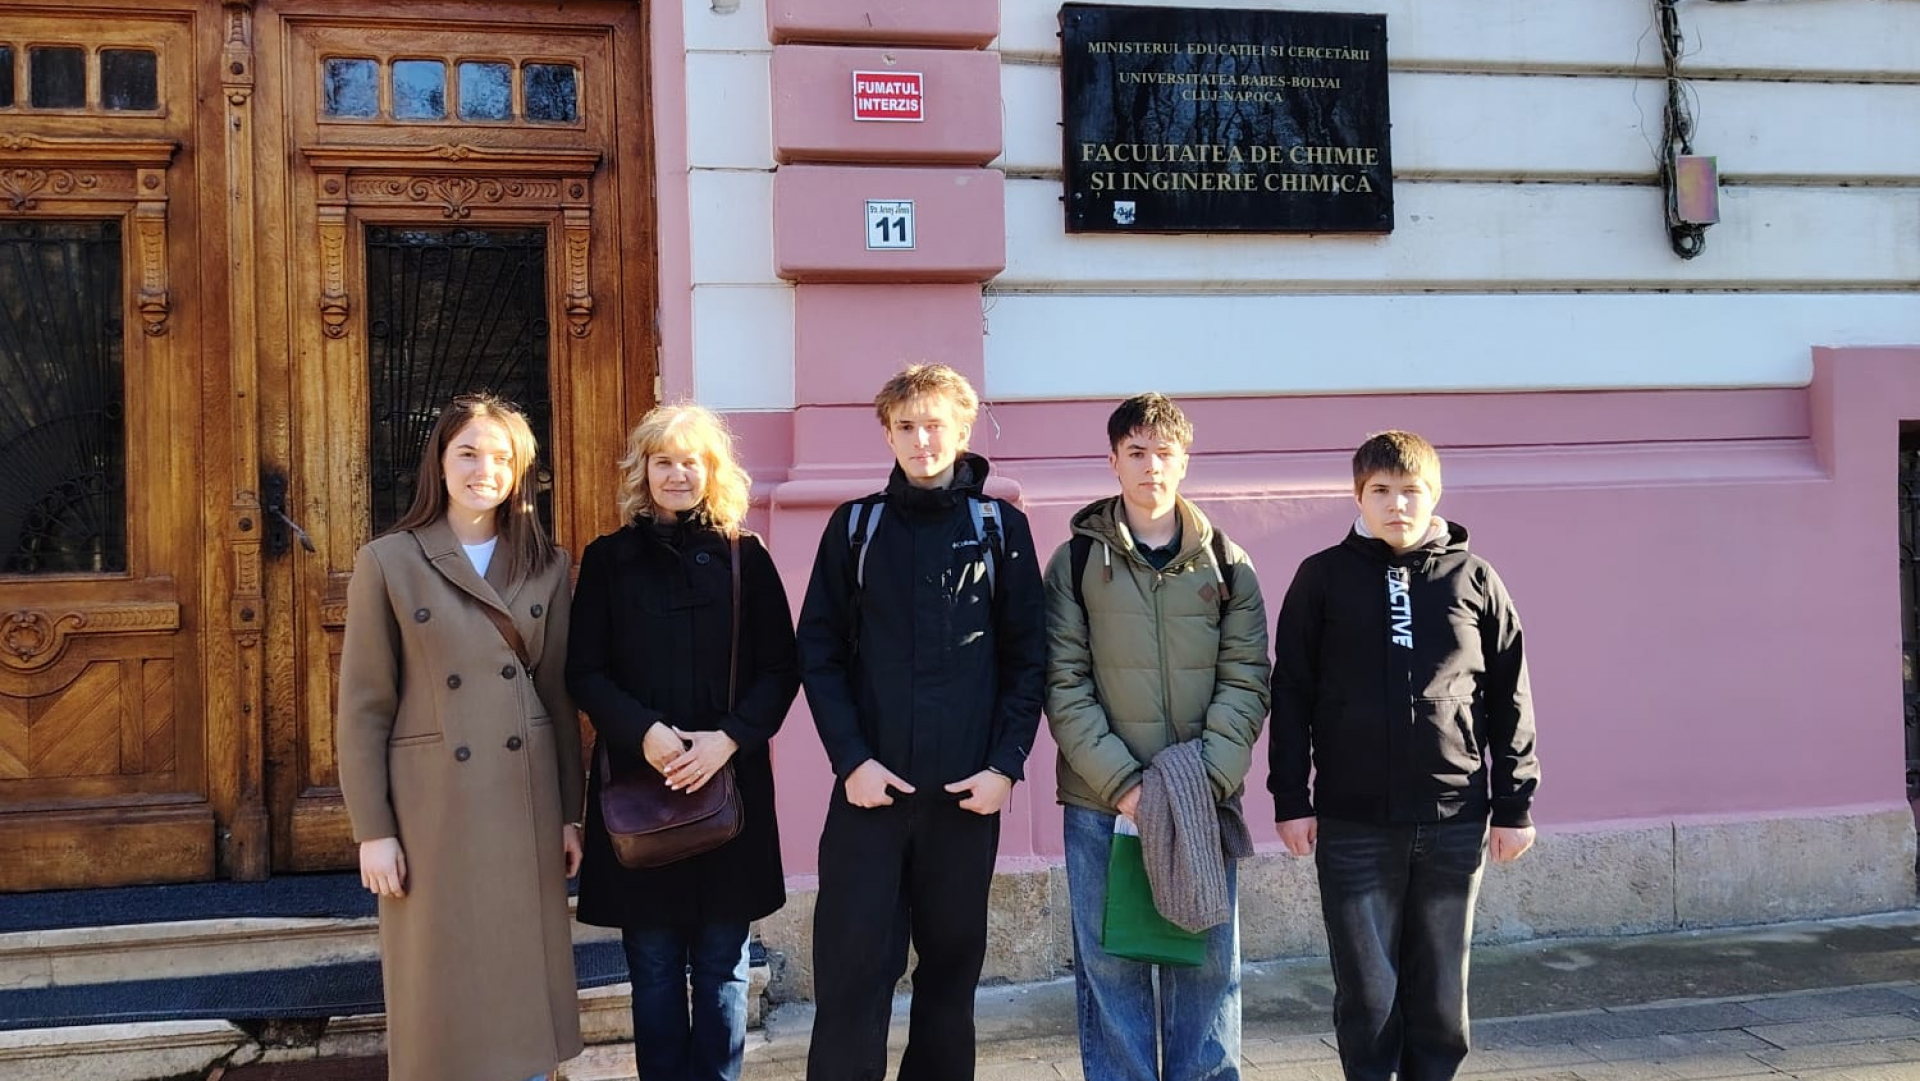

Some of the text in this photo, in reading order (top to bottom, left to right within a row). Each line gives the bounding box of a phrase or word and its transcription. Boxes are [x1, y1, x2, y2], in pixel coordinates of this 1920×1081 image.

[1088, 41, 1182, 54] MINISTERUL
[1119, 72, 1236, 85] UNIVERSITATEA
[858, 81, 919, 95] FUMATUL
[1182, 90, 1283, 102] CLUJ-NAPOCA
[858, 97, 919, 111] INTERZIS
[1082, 143, 1379, 165] FACULTATEA DE CHIMIE
[1121, 172, 1258, 191] INGINERIE
[876, 216, 906, 242] 11
